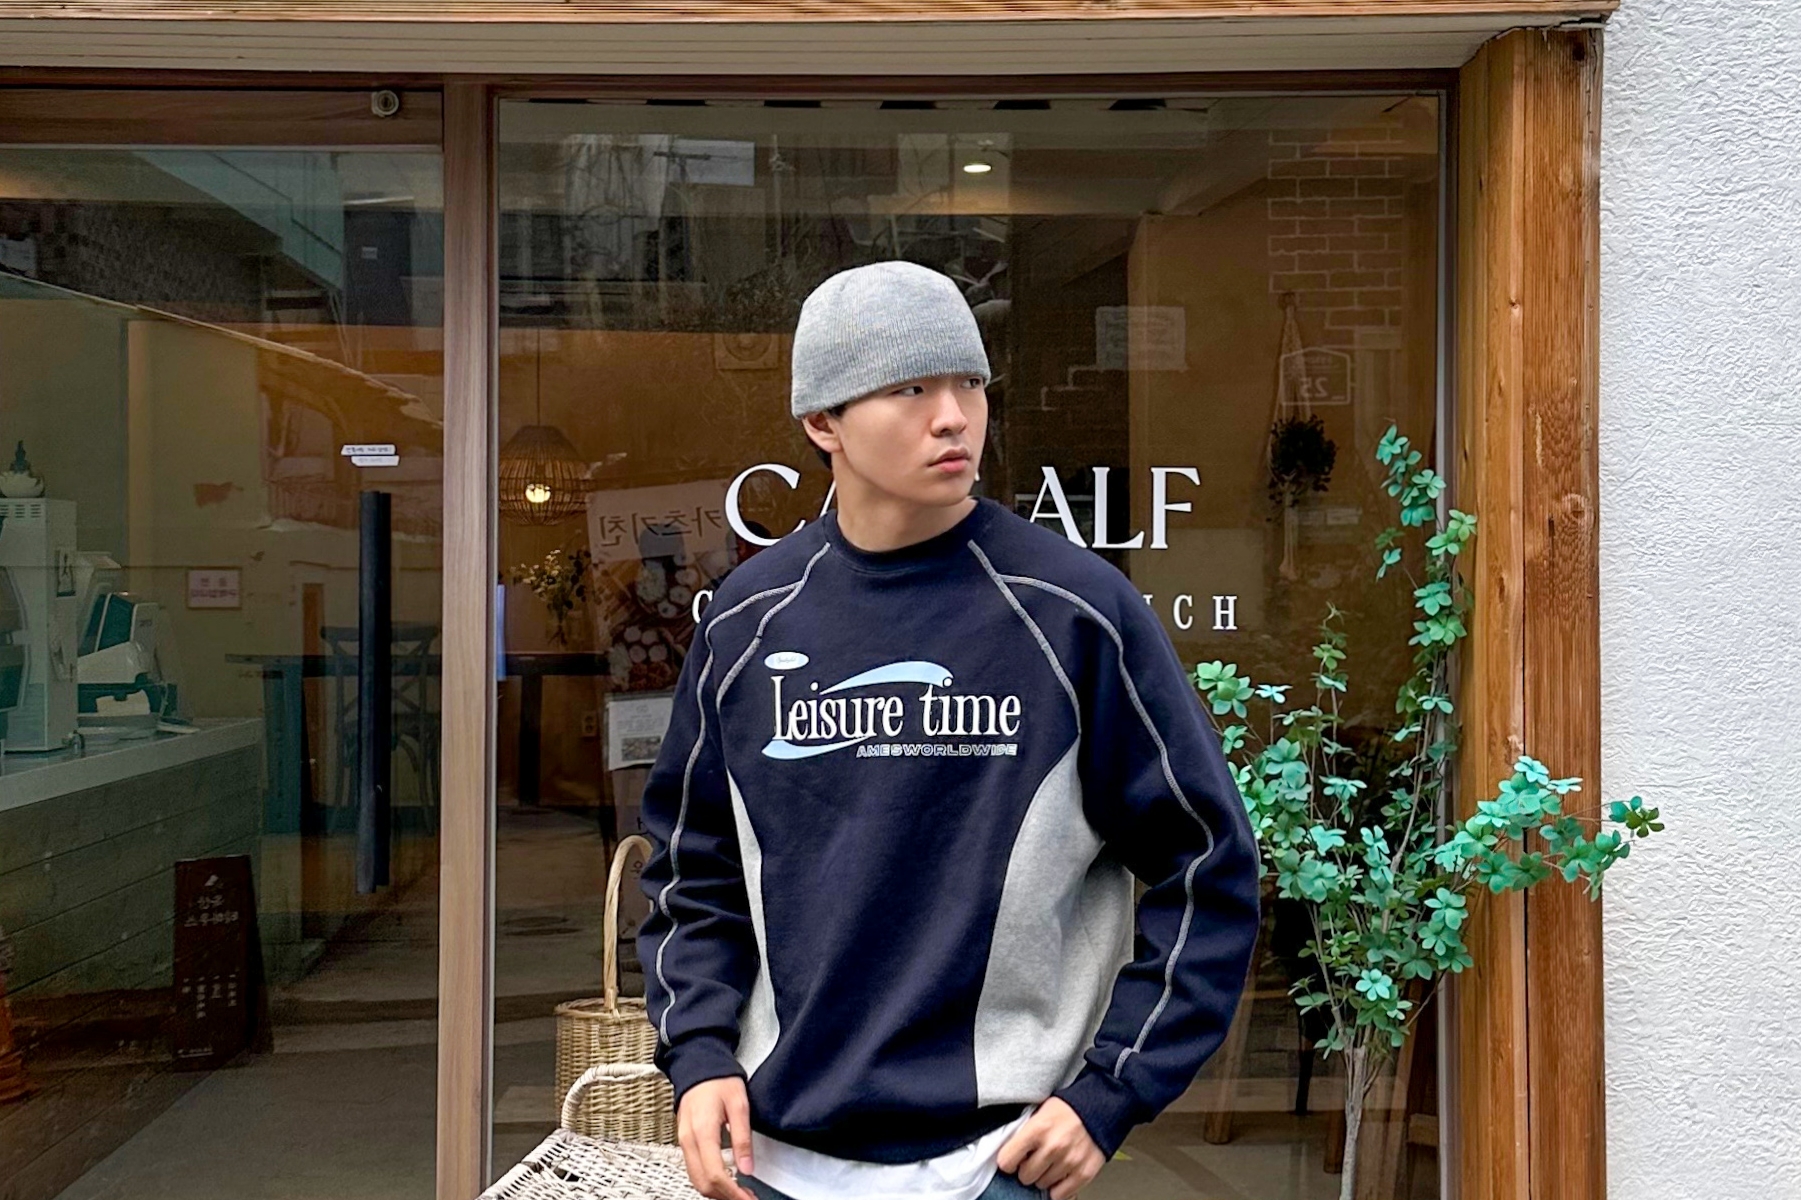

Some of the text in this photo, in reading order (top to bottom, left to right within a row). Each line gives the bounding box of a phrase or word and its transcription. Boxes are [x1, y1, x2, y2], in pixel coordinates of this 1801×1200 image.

[1029, 465, 1201, 549] ALF
[770, 674, 1022, 741] Leisure time
[856, 743, 1019, 758] AMESWORLDWIDE
